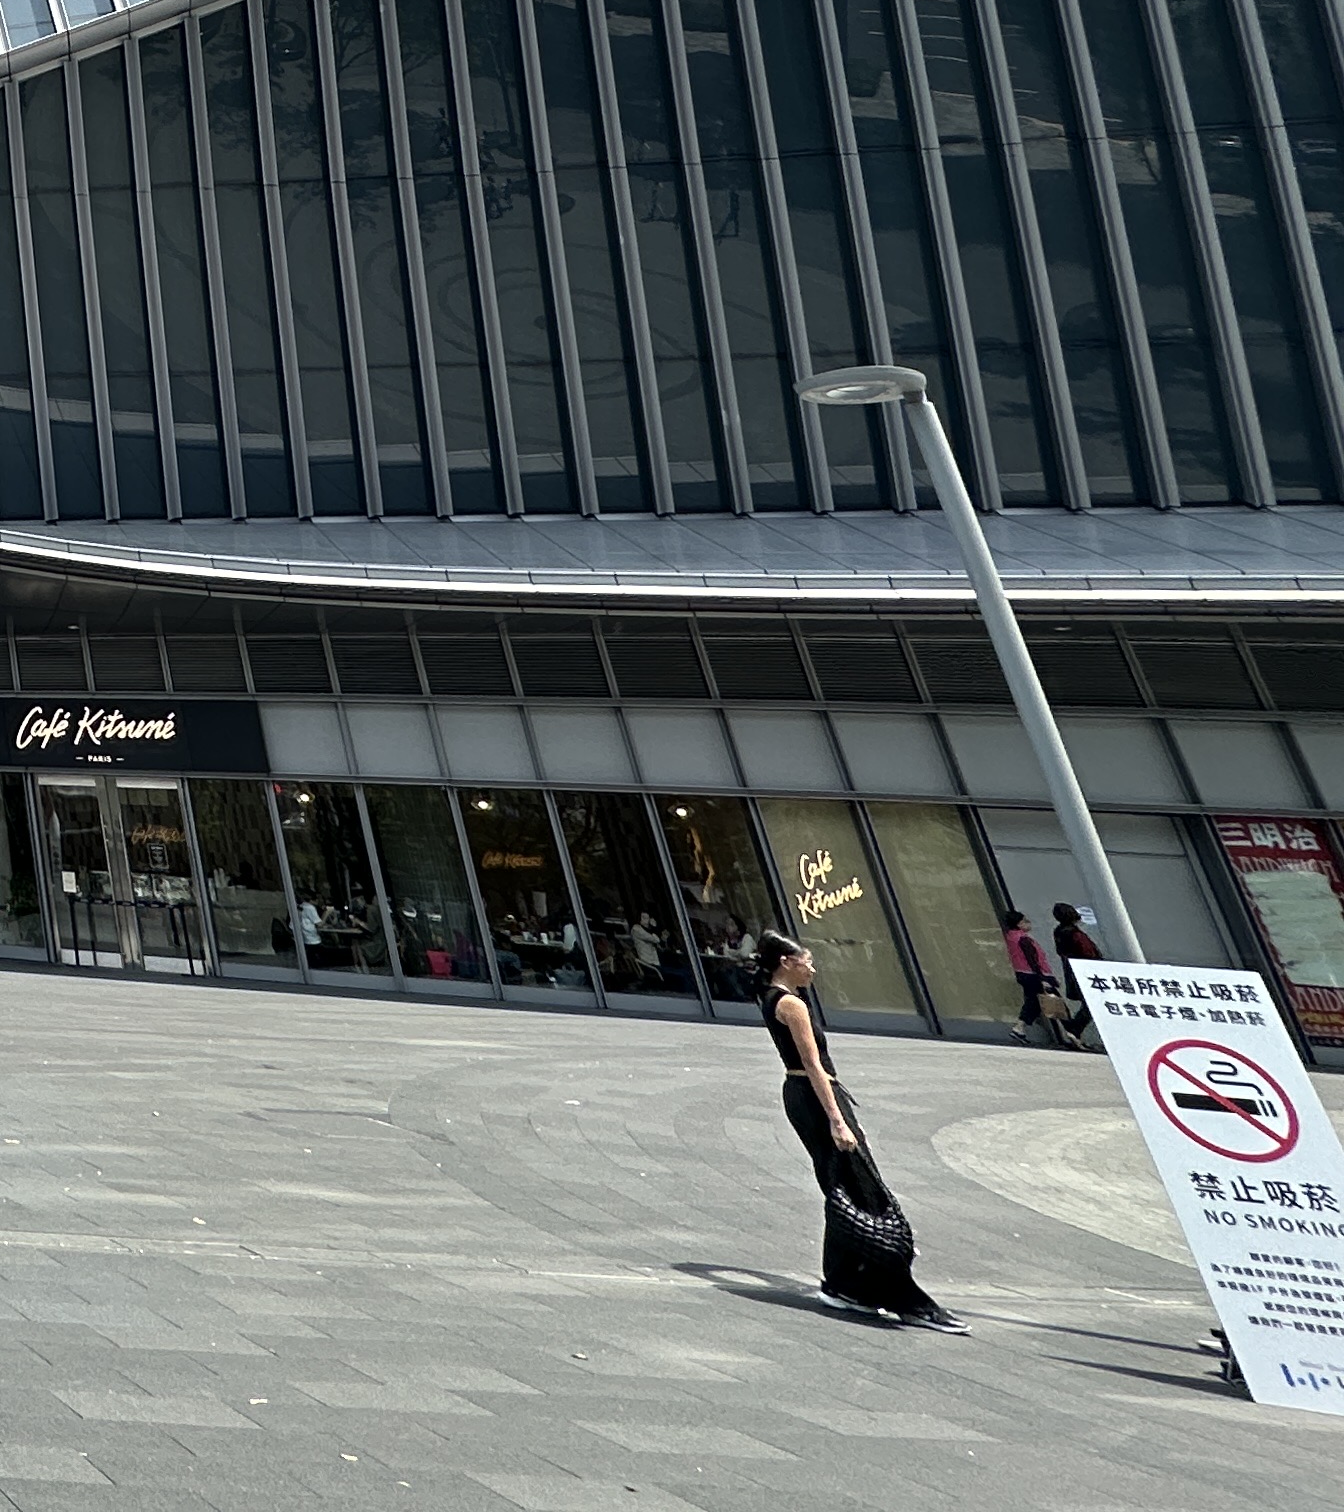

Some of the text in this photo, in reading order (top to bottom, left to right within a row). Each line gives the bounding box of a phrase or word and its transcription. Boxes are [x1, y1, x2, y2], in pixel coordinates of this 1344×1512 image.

[15, 705, 177, 750] Café Kitsuné
[87, 754, 113, 763] PARIS
[1216, 822, 1322, 851] 三明治
[799, 849, 833, 890] Café
[795, 877, 864, 925] Kitsuné
[1087, 974, 1263, 1004] 本場所禁止吸菸
[1188, 1171, 1341, 1214] 禁止吸菸
[1203, 1208, 1237, 1226] NO
